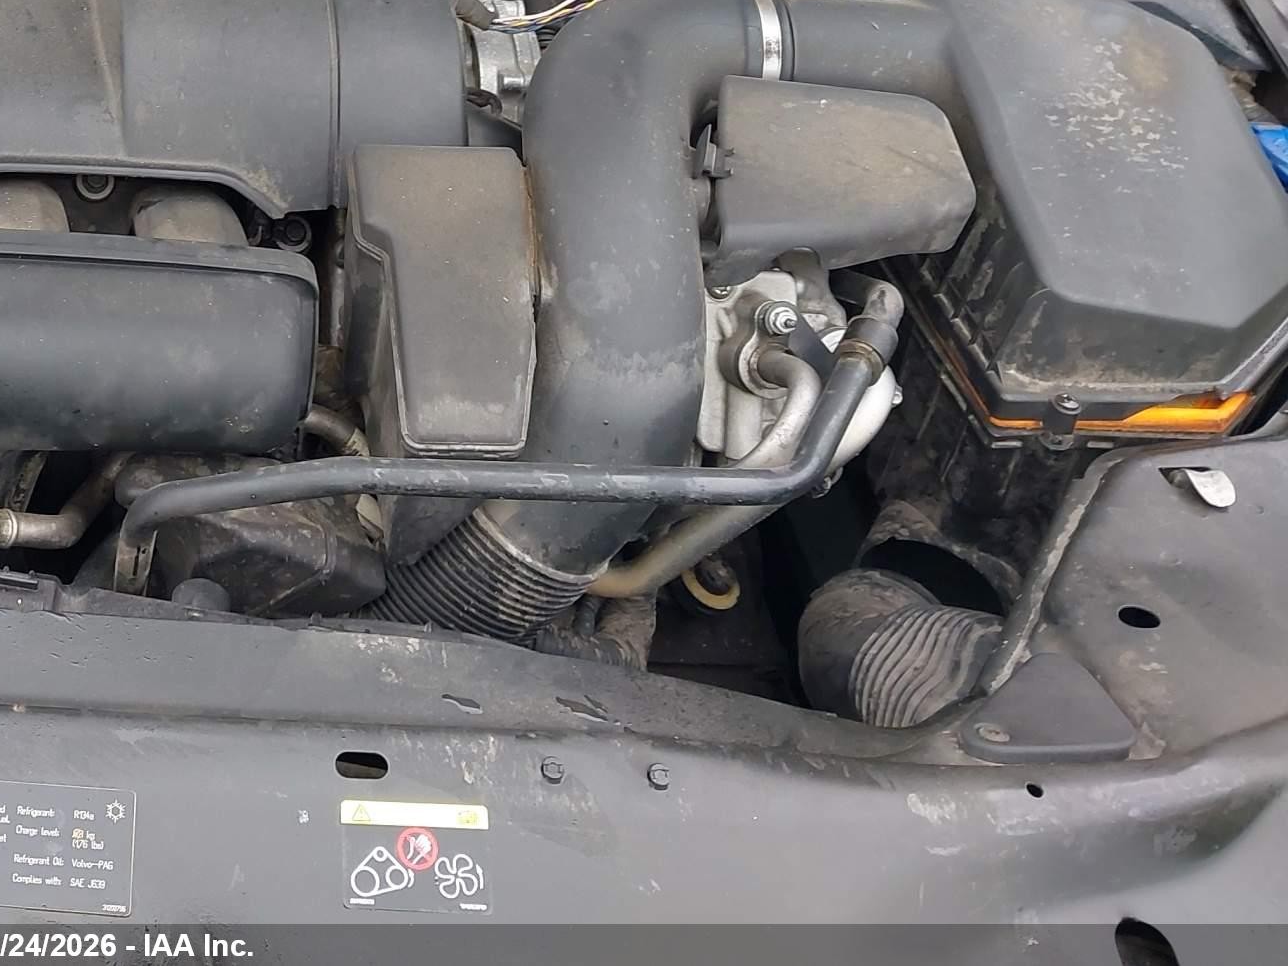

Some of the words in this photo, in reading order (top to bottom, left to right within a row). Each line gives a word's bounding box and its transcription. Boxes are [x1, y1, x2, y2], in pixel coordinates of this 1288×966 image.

[17, 806, 55, 817] Refrigerant:
[16, 825, 38, 836] Charge
[14, 854, 49, 866] Refrigerant
[72, 859, 113, 870] Volvo-PAG
[13, 874, 42, 884] Complies
[70, 878, 85, 887] SAE
